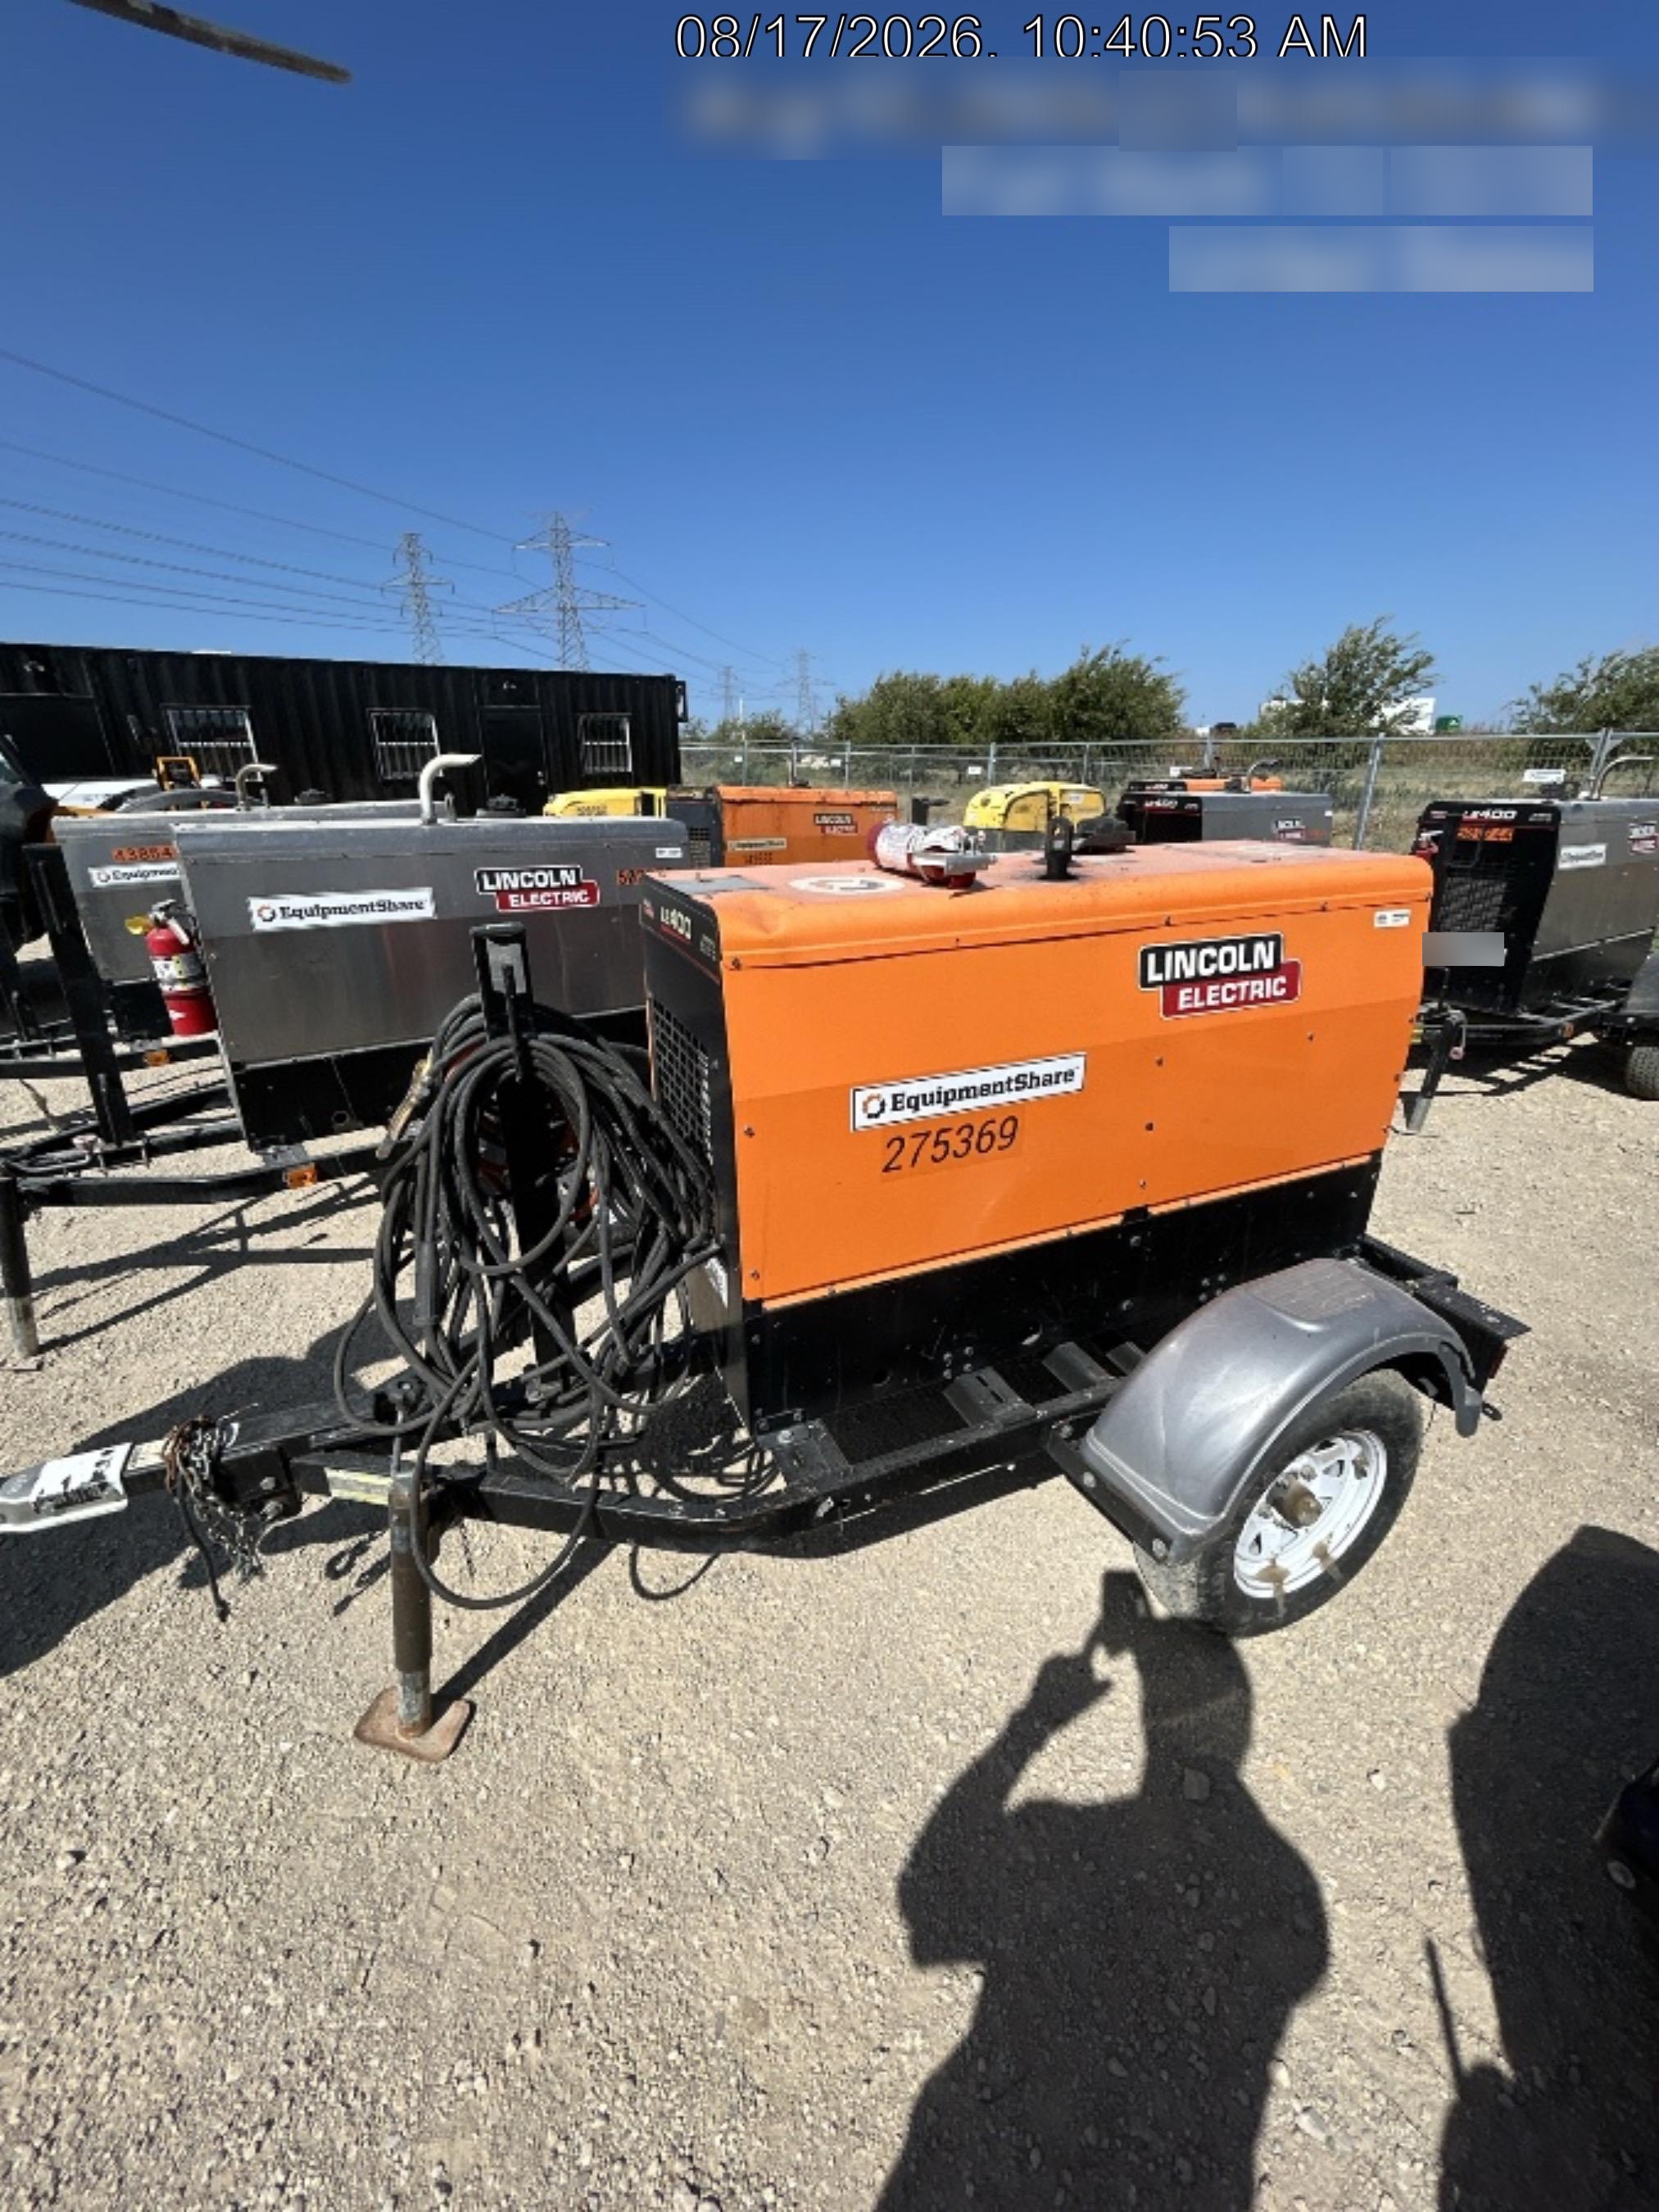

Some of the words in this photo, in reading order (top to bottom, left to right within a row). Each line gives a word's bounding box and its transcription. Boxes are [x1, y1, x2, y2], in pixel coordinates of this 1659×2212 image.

[482, 869, 578, 891] LINCOLN
[279, 898, 424, 920] EquipmentShare
[507, 889, 591, 908] ELECTRIC
[1147, 941, 1275, 983] LINCOLN
[1178, 975, 1287, 1011] ELECTRIC
[891, 1067, 1077, 1113] EquipmentShare
[882, 1115, 1019, 1173] 275369
